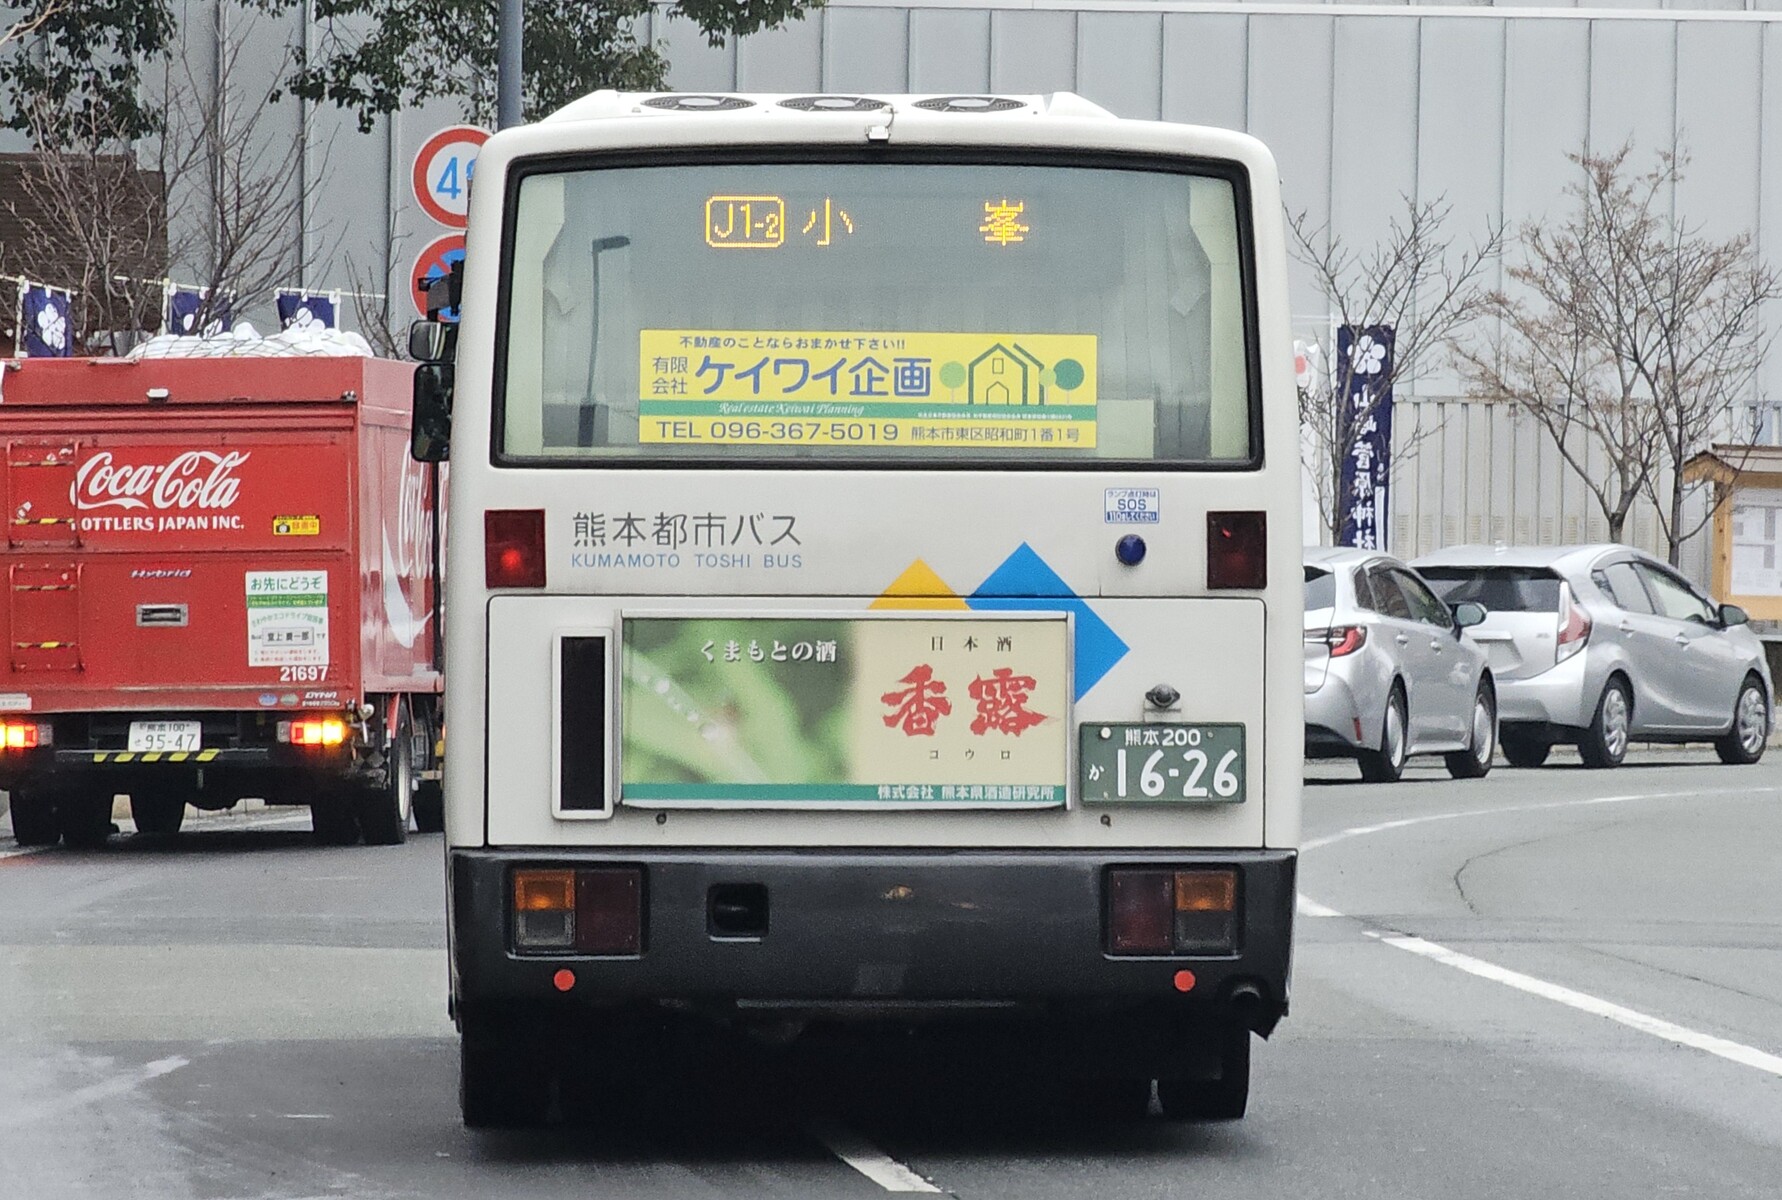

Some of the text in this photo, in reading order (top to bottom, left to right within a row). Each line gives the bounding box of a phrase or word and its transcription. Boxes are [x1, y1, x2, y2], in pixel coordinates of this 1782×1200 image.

[714, 202, 779, 239] J1-2
[653, 355, 688, 374] 有限
[653, 377, 687, 394] 会社
[695, 355, 932, 397] ケイワイ企画
[656, 421, 898, 440] TEL 096-367-5019
[70, 451, 250, 509] Coca-Cola
[1117, 499, 1146, 510] SOS
[158, 516, 208, 532] JAPAN
[212, 515, 245, 530] INC.
[572, 512, 801, 549] 熊本都市バス
[571, 553, 802, 568] KUMAMOTO TOSHI BUS
[131, 569, 192, 578] Hybrid
[251, 576, 322, 591] お先にどうぞ
[701, 640, 837, 662] くまもとの酒
[280, 665, 328, 681] 21697
[881, 664, 1049, 737] 香露
[145, 733, 196, 752] 95-47
[1088, 749, 1238, 797] か 16-26
[878, 784, 934, 800] 株式会社
